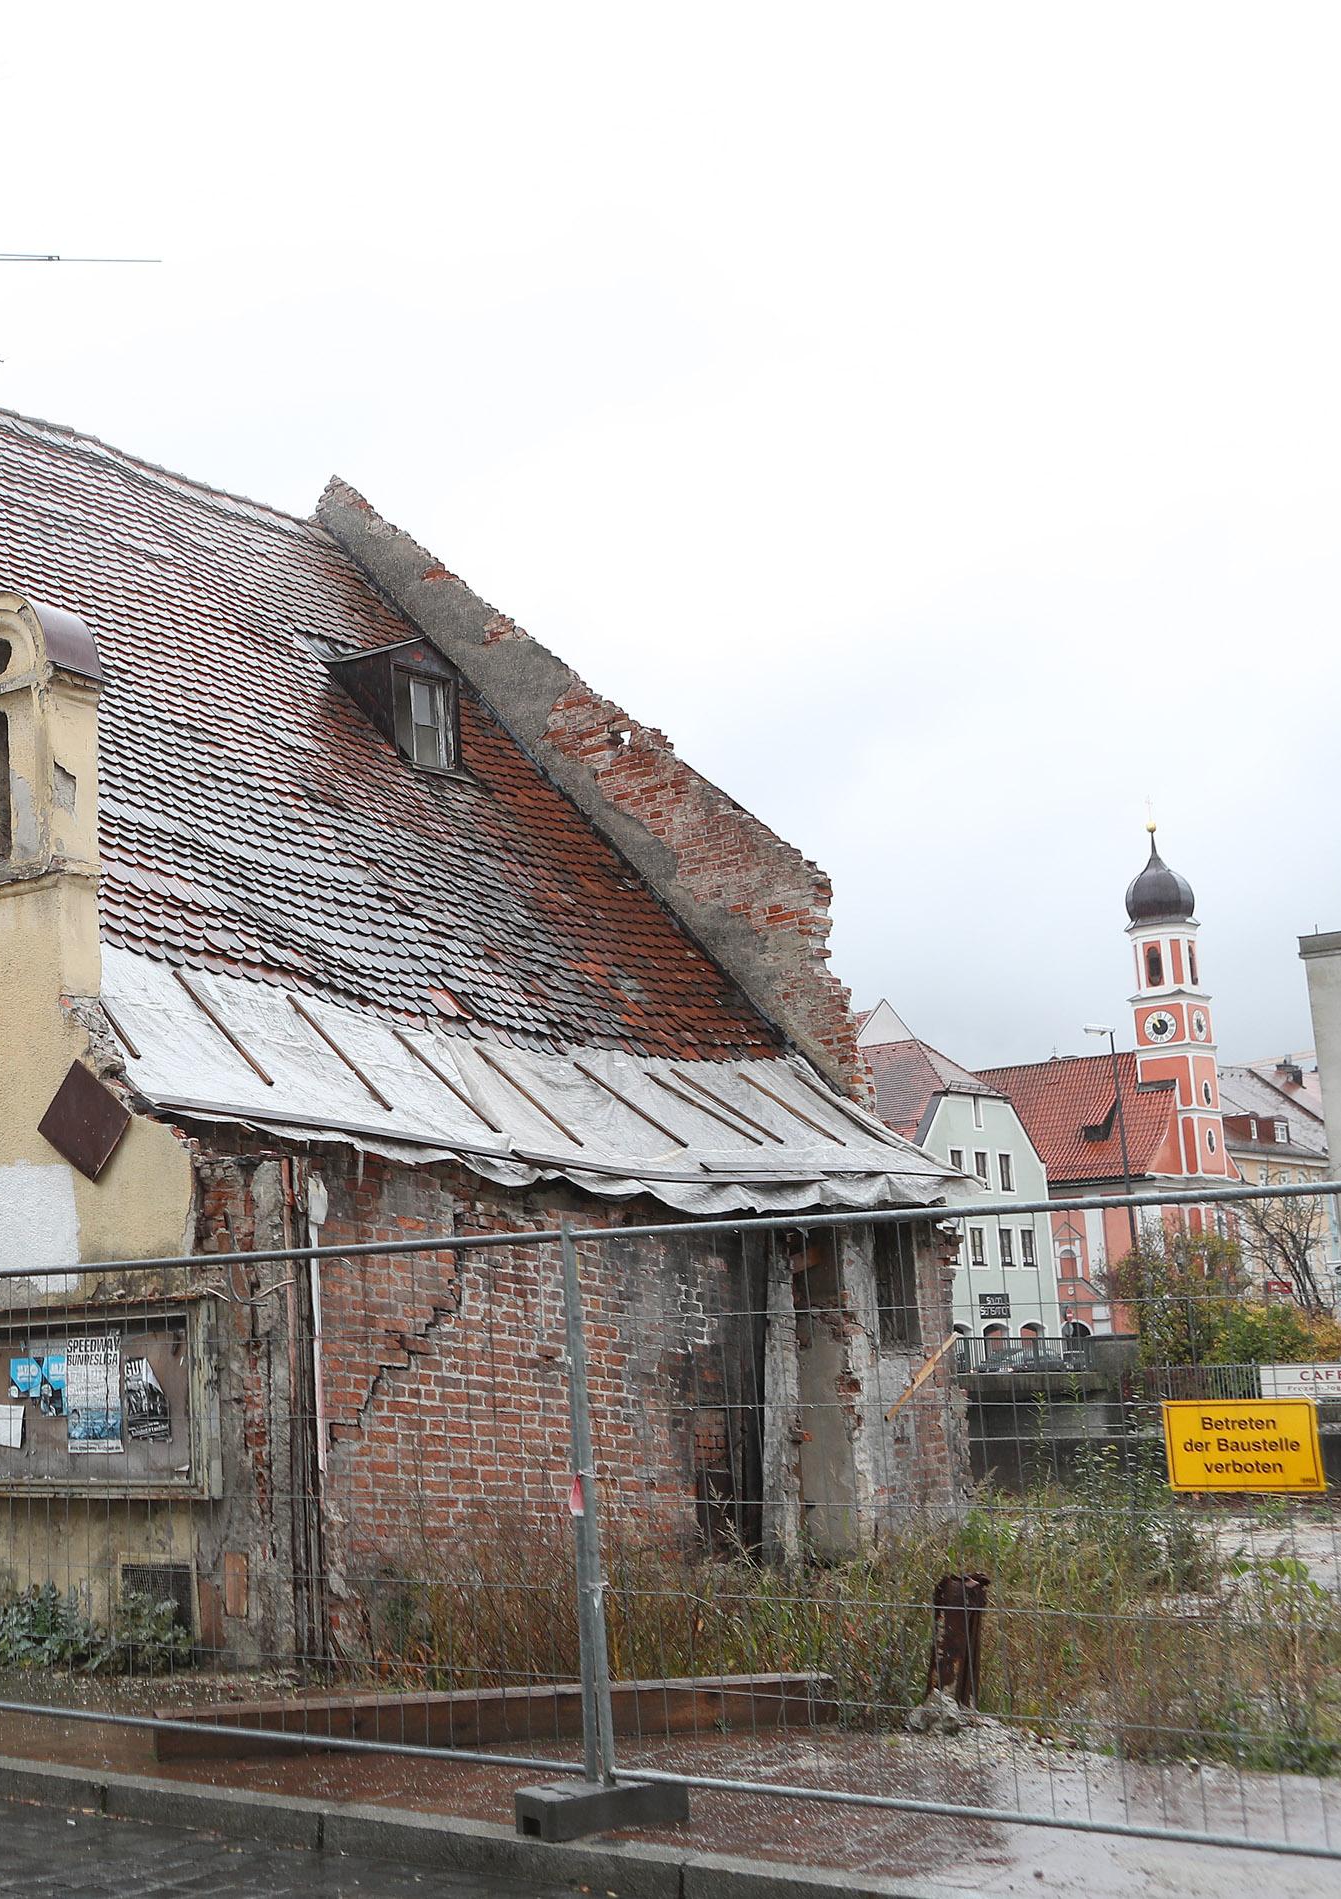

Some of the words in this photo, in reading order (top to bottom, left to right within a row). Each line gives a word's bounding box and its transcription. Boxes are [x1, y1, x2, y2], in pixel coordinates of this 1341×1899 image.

[66, 1335, 121, 1354] SPEEDWAY
[67, 1353, 119, 1367] BUNDESLIGA
[1201, 1417, 1276, 1430] Betreten
[1184, 1438, 1211, 1452] der
[1217, 1438, 1300, 1452] Baustelle
[1204, 1459, 1283, 1474] verboten
